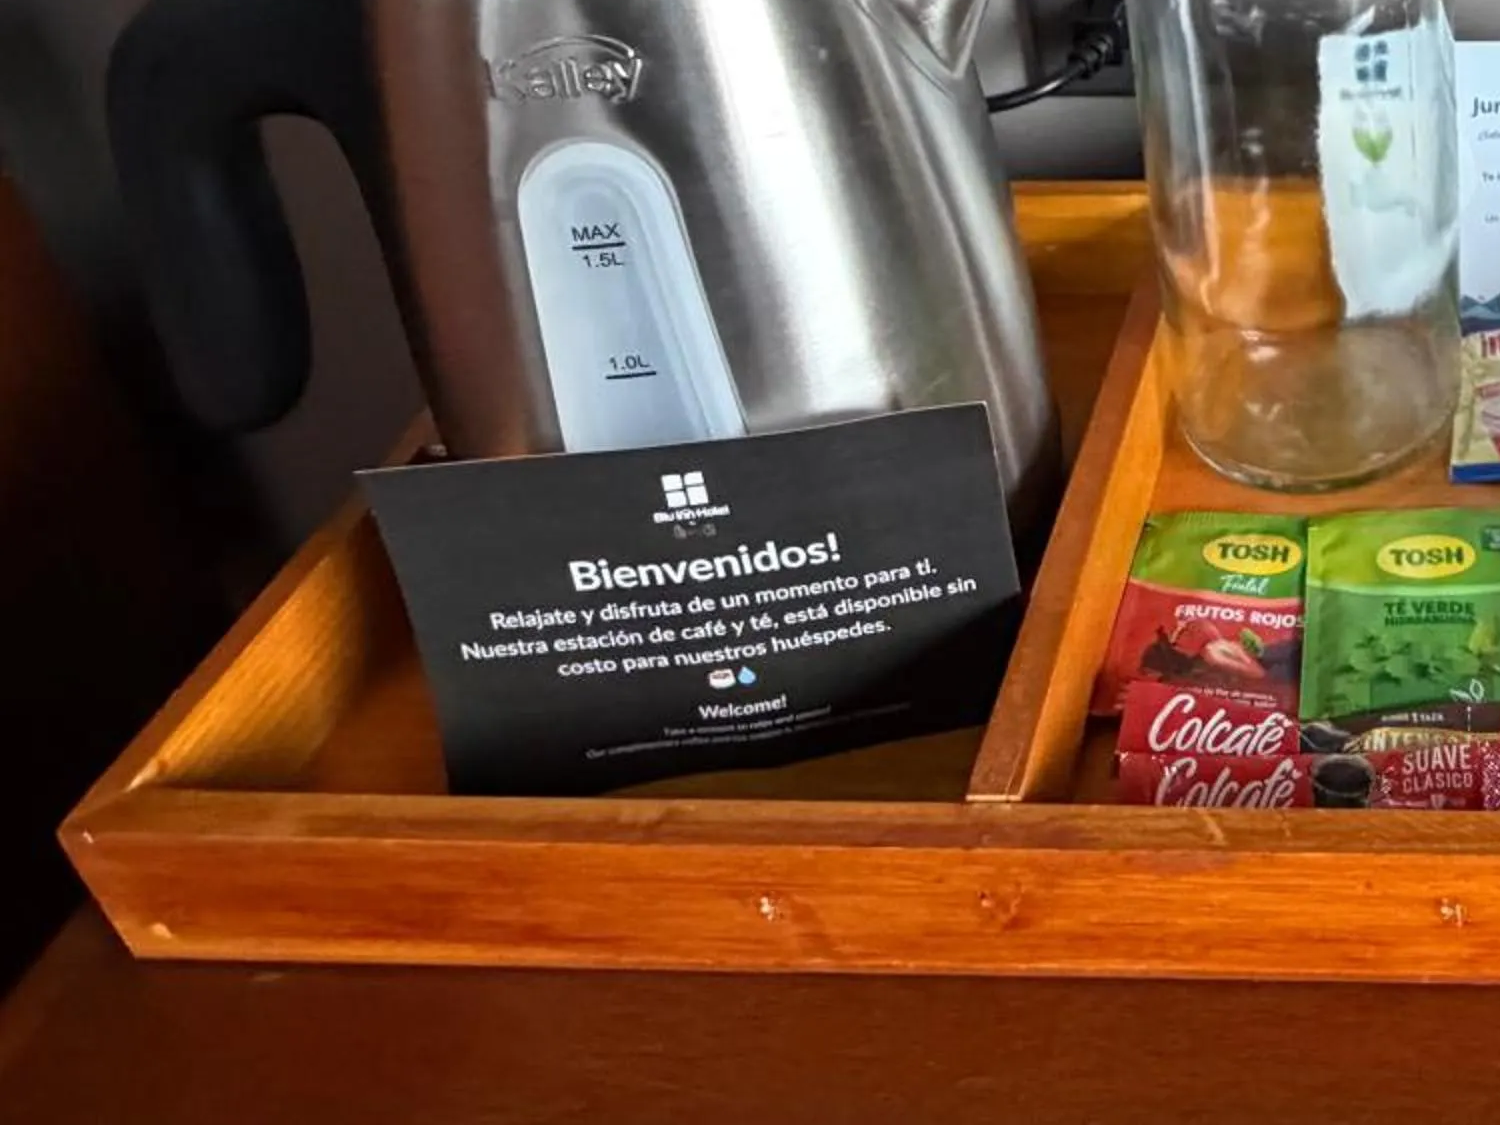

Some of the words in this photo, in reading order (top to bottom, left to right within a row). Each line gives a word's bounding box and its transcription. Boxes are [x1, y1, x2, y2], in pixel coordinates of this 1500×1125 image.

[484, 56, 643, 105] Kalley
[571, 223, 622, 242] MAX
[582, 252, 625, 268] 1.5L
[608, 354, 651, 371] 1.0L
[568, 532, 842, 592] Bienvenidos!
[1217, 542, 1291, 564] TOSH
[1389, 546, 1465, 566] TOSH
[489, 607, 578, 631] Relajate
[581, 607, 595, 627] y
[599, 599, 683, 622] disfruta
[687, 595, 717, 613] de
[721, 592, 750, 612] un
[755, 575, 859, 605] momento
[863, 564, 911, 590] para
[915, 558, 938, 576] ti.
[1411, 600, 1476, 617] VERDE
[460, 639, 549, 660] Nuestra
[553, 629, 644, 653] estación
[648, 626, 677, 645] de
[681, 620, 727, 642] café
[731, 620, 745, 637] y
[749, 613, 779, 632] té,
[784, 603, 829, 625] está
[833, 584, 943, 618] disponible
[947, 576, 978, 596] sin
[1174, 604, 1246, 622] FRUTOS
[557, 659, 617, 677] costo
[621, 655, 670, 674] para
[674, 638, 768, 667] nuestros
[770, 618, 893, 654] huéspedes.
[697, 693, 788, 721] Welcome!
[1147, 692, 1293, 757] Colcafé
[1402, 744, 1472, 775] SUAVE
